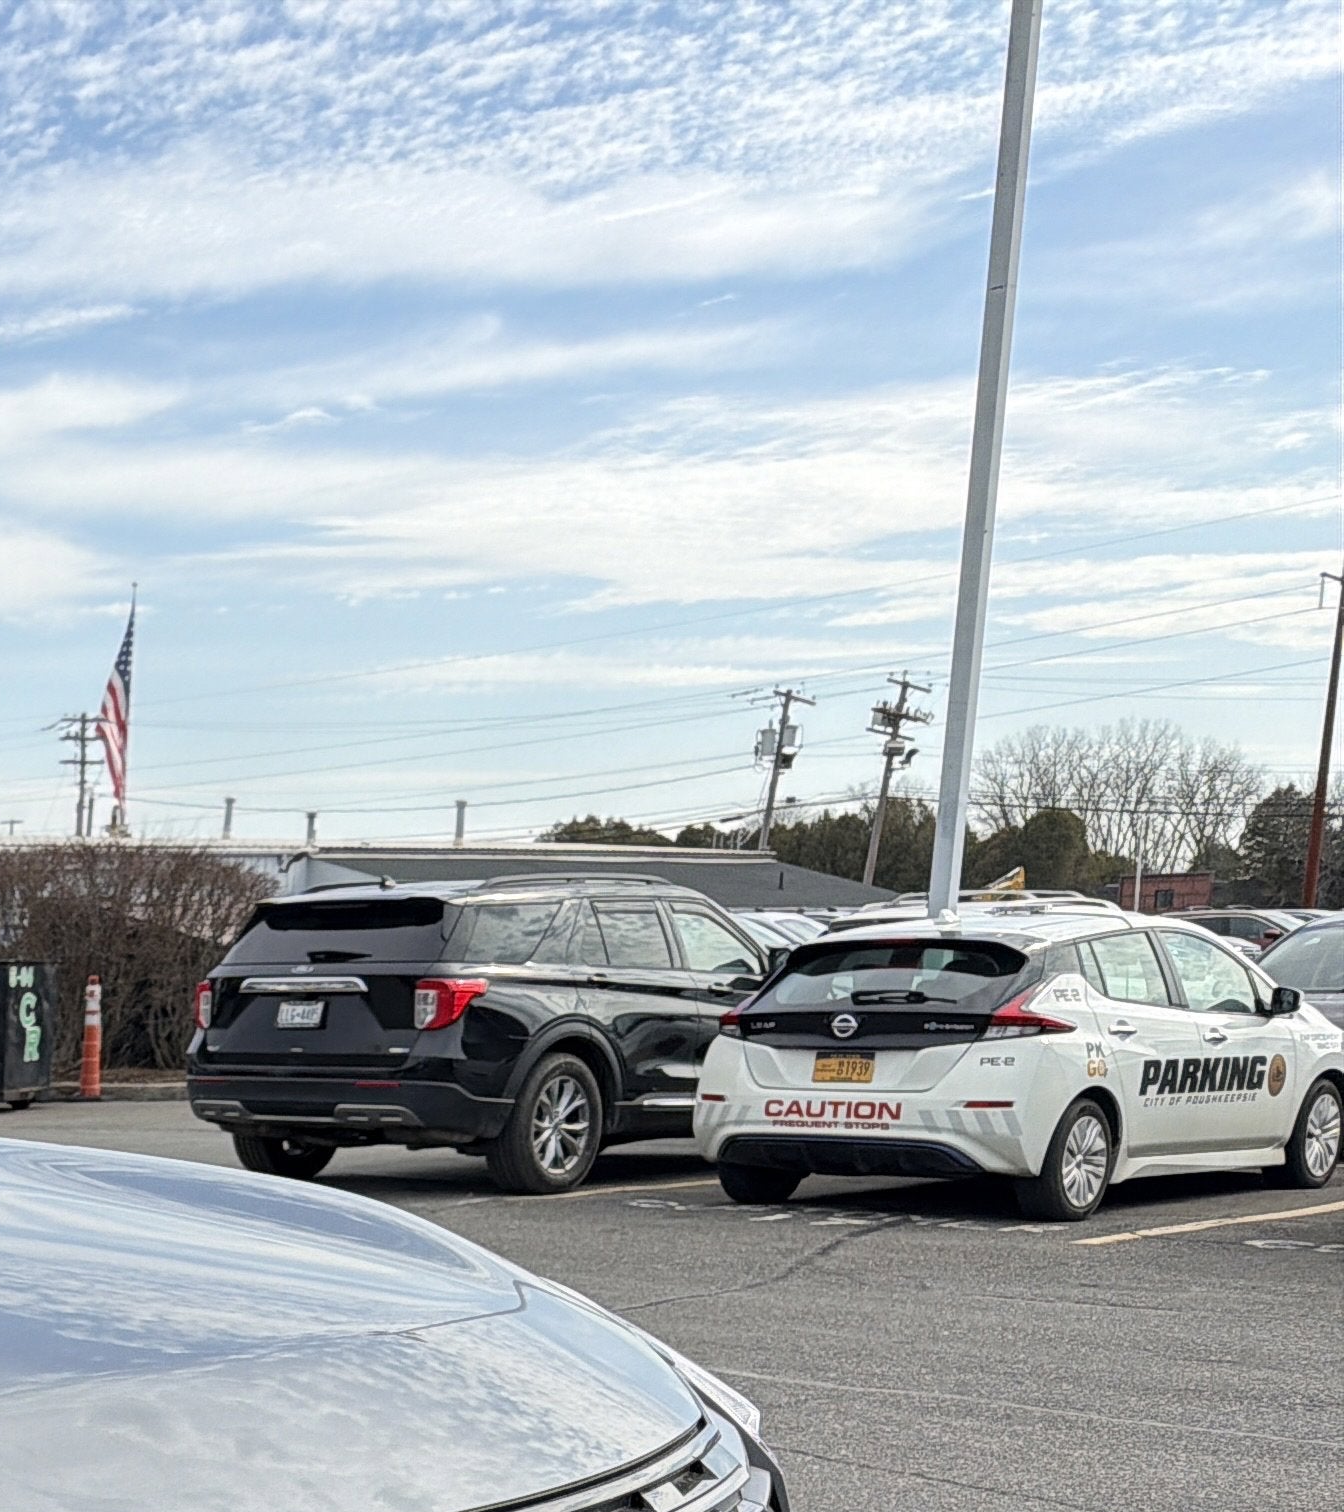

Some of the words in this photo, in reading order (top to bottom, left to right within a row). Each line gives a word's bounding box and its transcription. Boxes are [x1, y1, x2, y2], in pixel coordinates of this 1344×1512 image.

[1139, 1055, 1268, 1097] PARKING
[764, 1099, 903, 1121] CAUTION
[1143, 1097, 1165, 1108] CITY
[1169, 1096, 1183, 1106] OF
[771, 1119, 838, 1130] FREQUENT
[843, 1120, 891, 1131] STOPS
